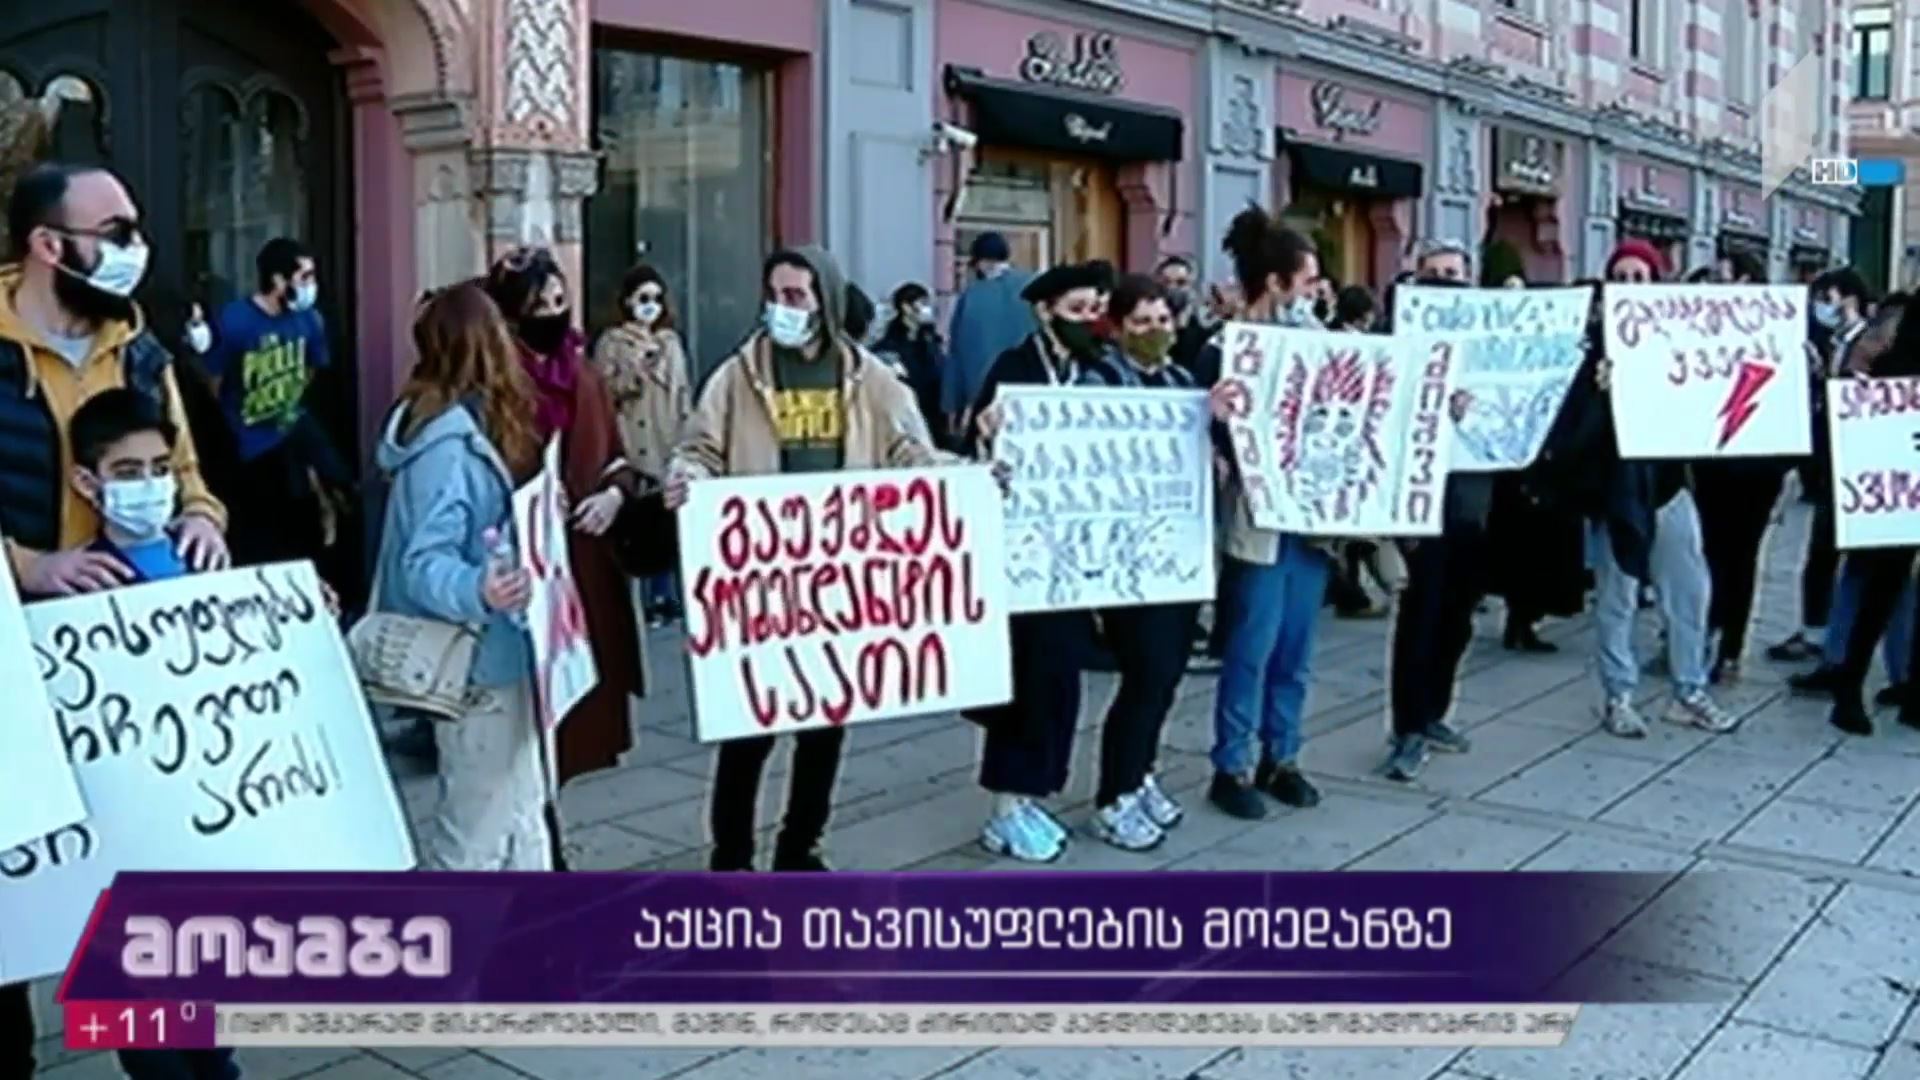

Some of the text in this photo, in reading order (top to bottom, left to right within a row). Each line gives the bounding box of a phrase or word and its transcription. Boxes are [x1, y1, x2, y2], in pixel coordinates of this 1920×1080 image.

[719, 477, 964, 570] გაუქმდეს
[32, 567, 316, 711] ავისუფლება
[684, 551, 985, 659] კომენდანტის
[740, 632, 948, 728] საათი
